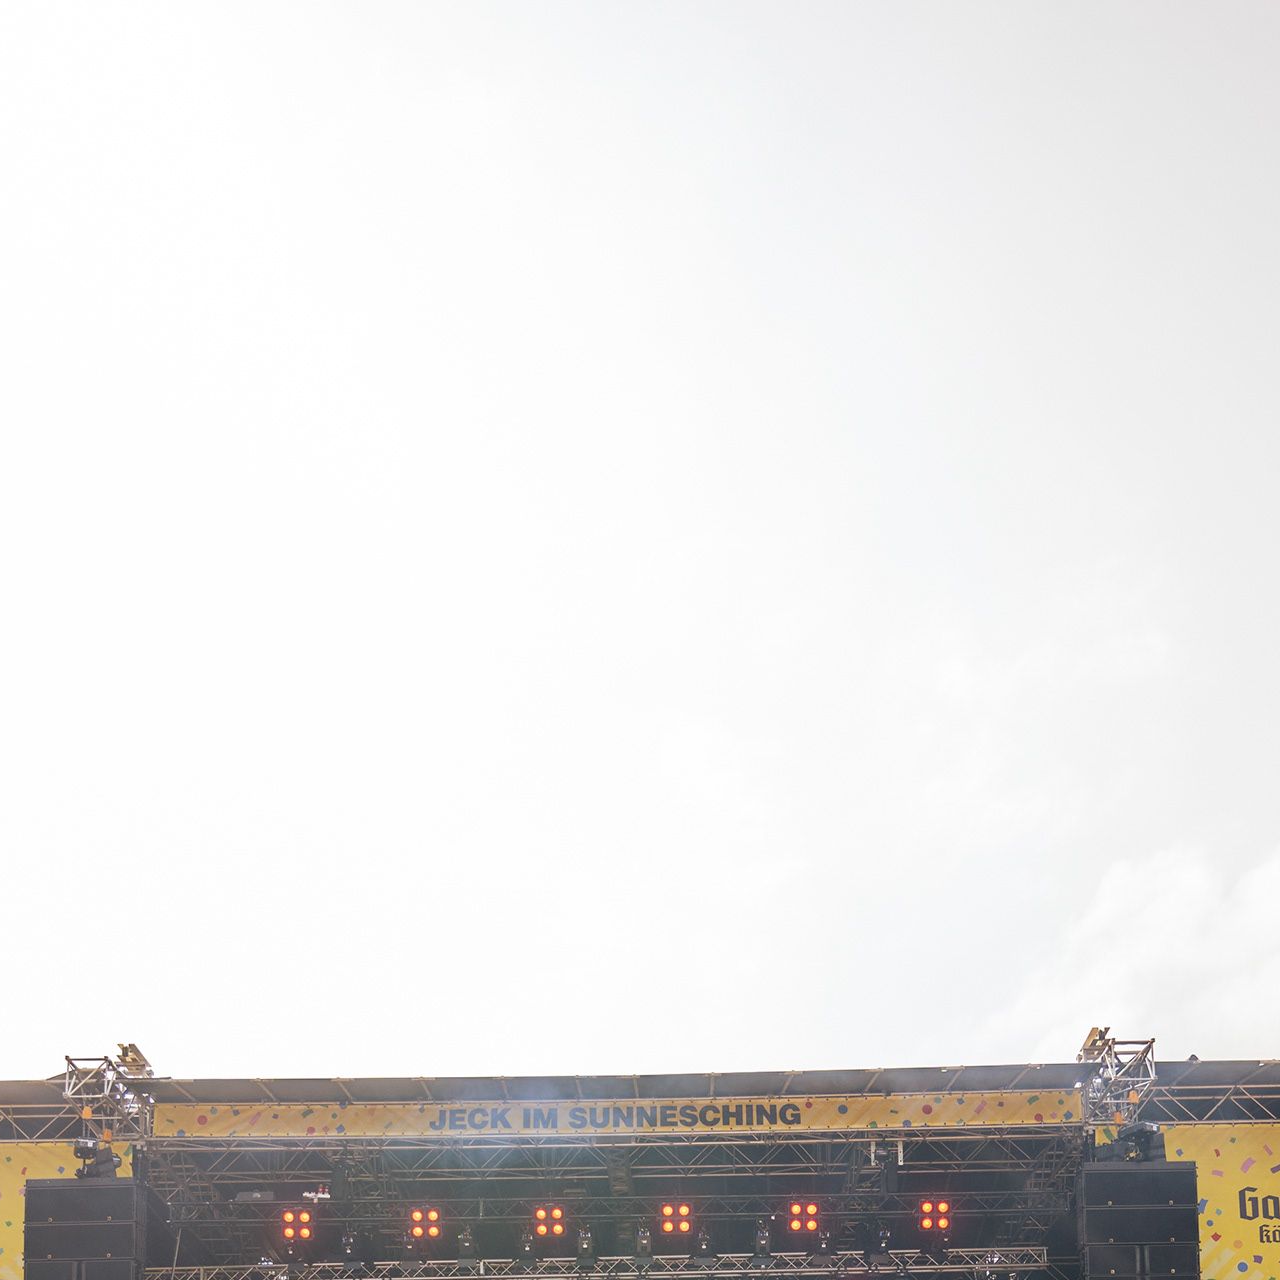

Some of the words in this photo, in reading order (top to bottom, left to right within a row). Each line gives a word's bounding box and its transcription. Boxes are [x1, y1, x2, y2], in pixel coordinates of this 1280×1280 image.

[429, 1108, 513, 1132] JECK
[523, 1108, 558, 1129] IM
[568, 1103, 802, 1129] SUNNESCHING
